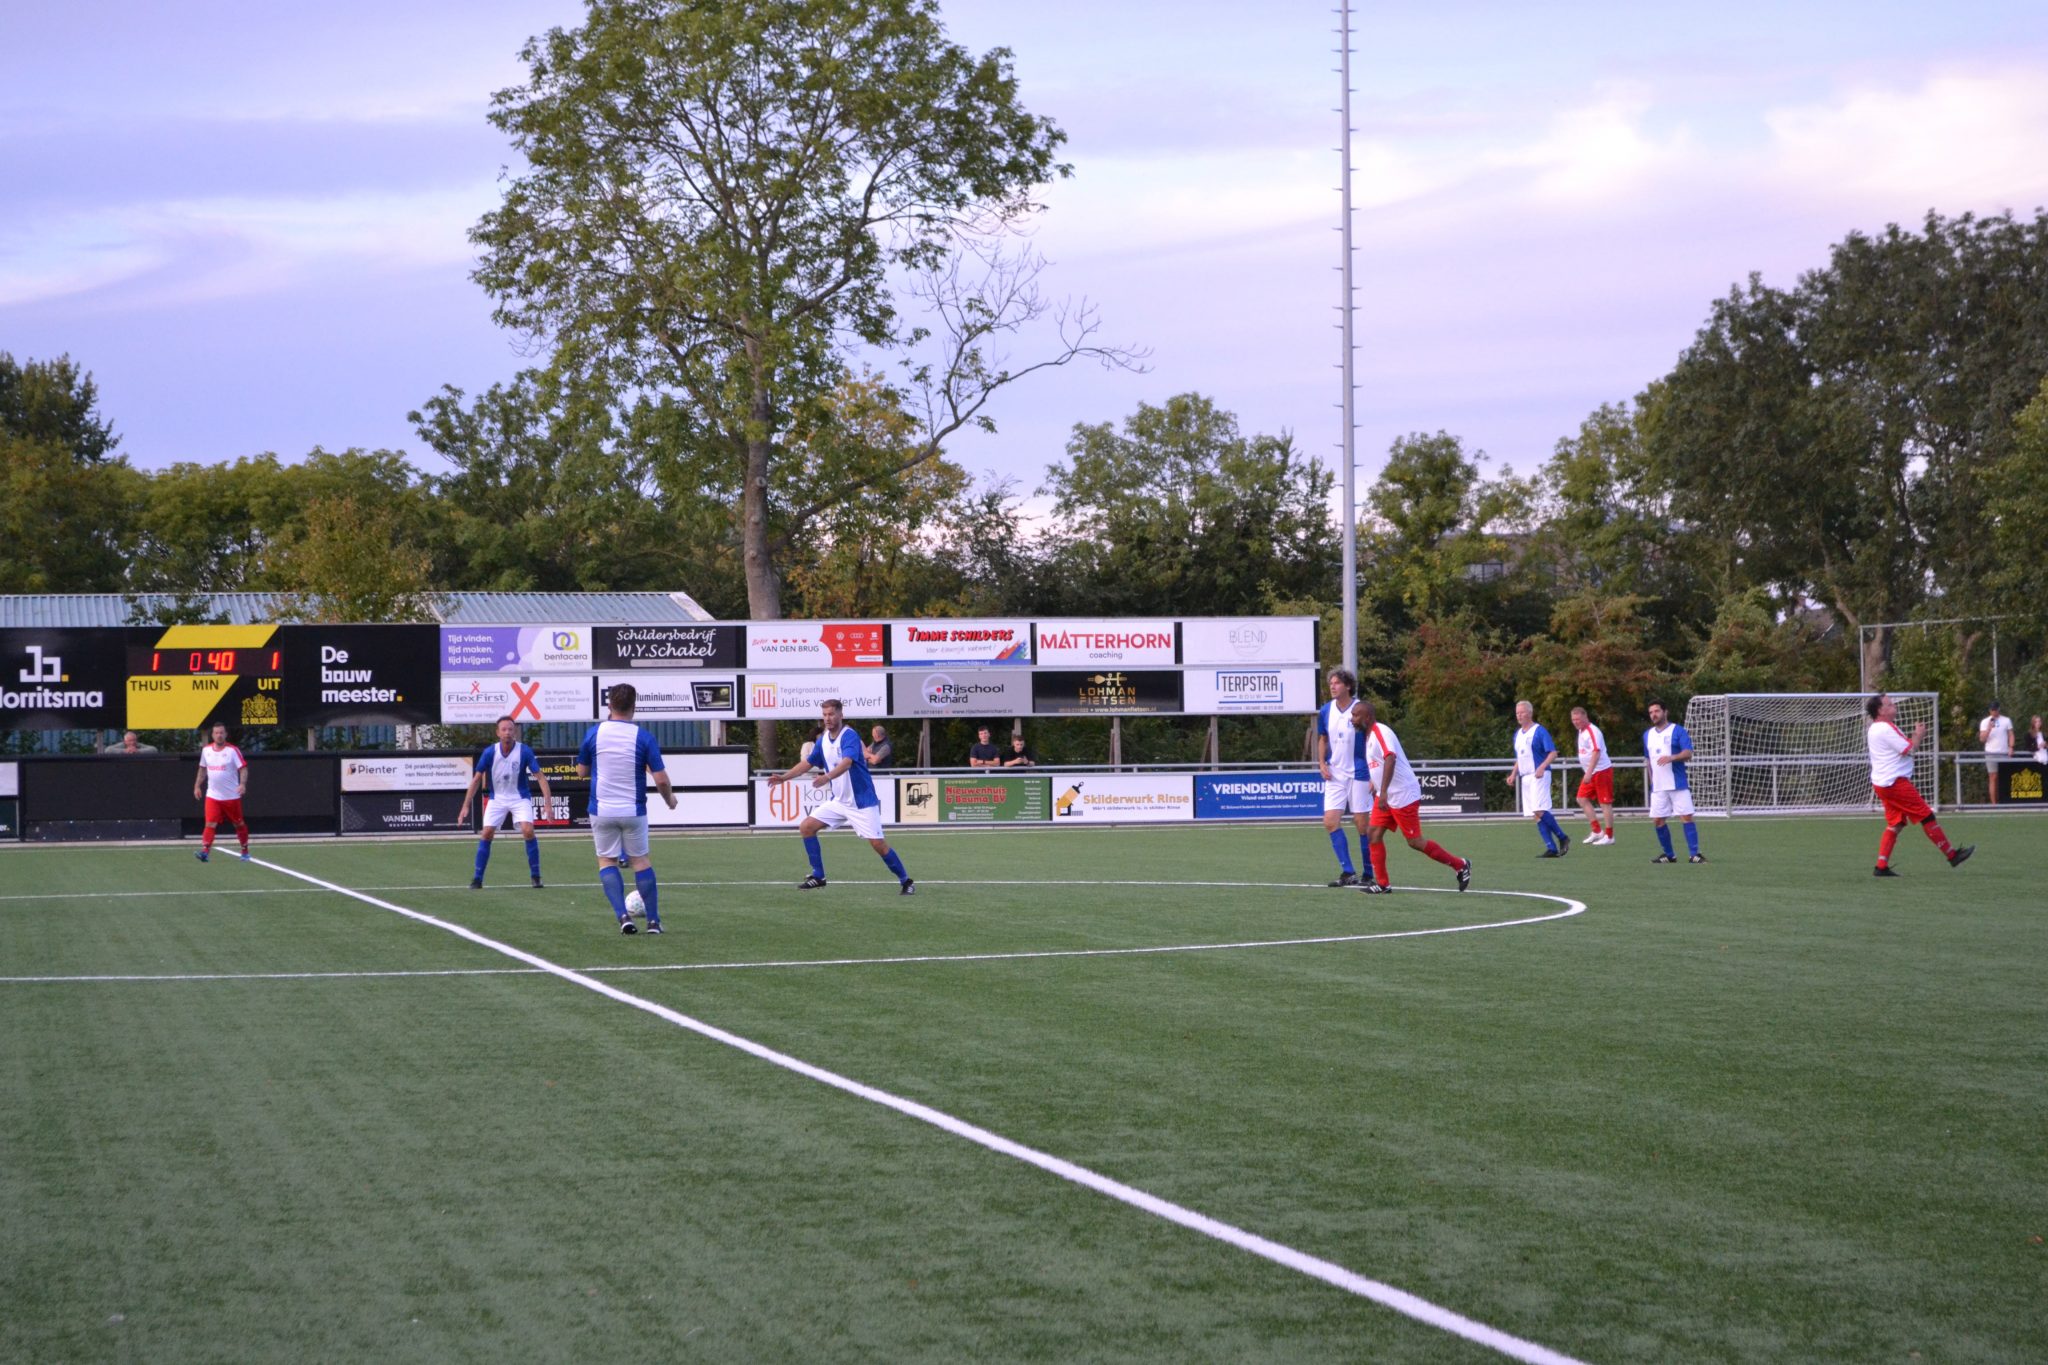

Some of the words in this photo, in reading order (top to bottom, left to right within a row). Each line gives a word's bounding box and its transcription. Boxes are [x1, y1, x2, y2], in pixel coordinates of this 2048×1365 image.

[616, 629, 716, 642] Schildersbedrijf
[907, 627, 948, 642] TIMME
[950, 629, 1014, 642] SCHILDERS
[1040, 630, 1171, 649] MATTERHORN
[321, 646, 349, 663] De
[1089, 652, 1123, 660] coaching
[152, 653, 160, 671] 1
[272, 652, 279, 670] 1
[321, 665, 373, 683] bouw
[130, 680, 172, 691] THUIS
[192, 679, 219, 690] MIN
[257, 678, 281, 690] UIT
[1221, 675, 1278, 692] TERPSTRA
[780, 687, 839, 695] Tegelgroothandel
[942, 684, 1004, 695] Rijschool
[1079, 687, 1136, 696] LOHMAN
[0, 685, 103, 709] orritsma
[447, 693, 505, 702] FlexFirst
[780, 698, 810, 708] Julius
[855, 697, 882, 707] Werf
[929, 695, 968, 703] Richard
[1079, 696, 1136, 705] FIETSEN
[358, 765, 397, 774] Pienter
[1212, 782, 1325, 794] VRIENDENLOTERIJ
[1083, 793, 1154, 805] Skilderwurk
[1157, 793, 1190, 804] Rinse
